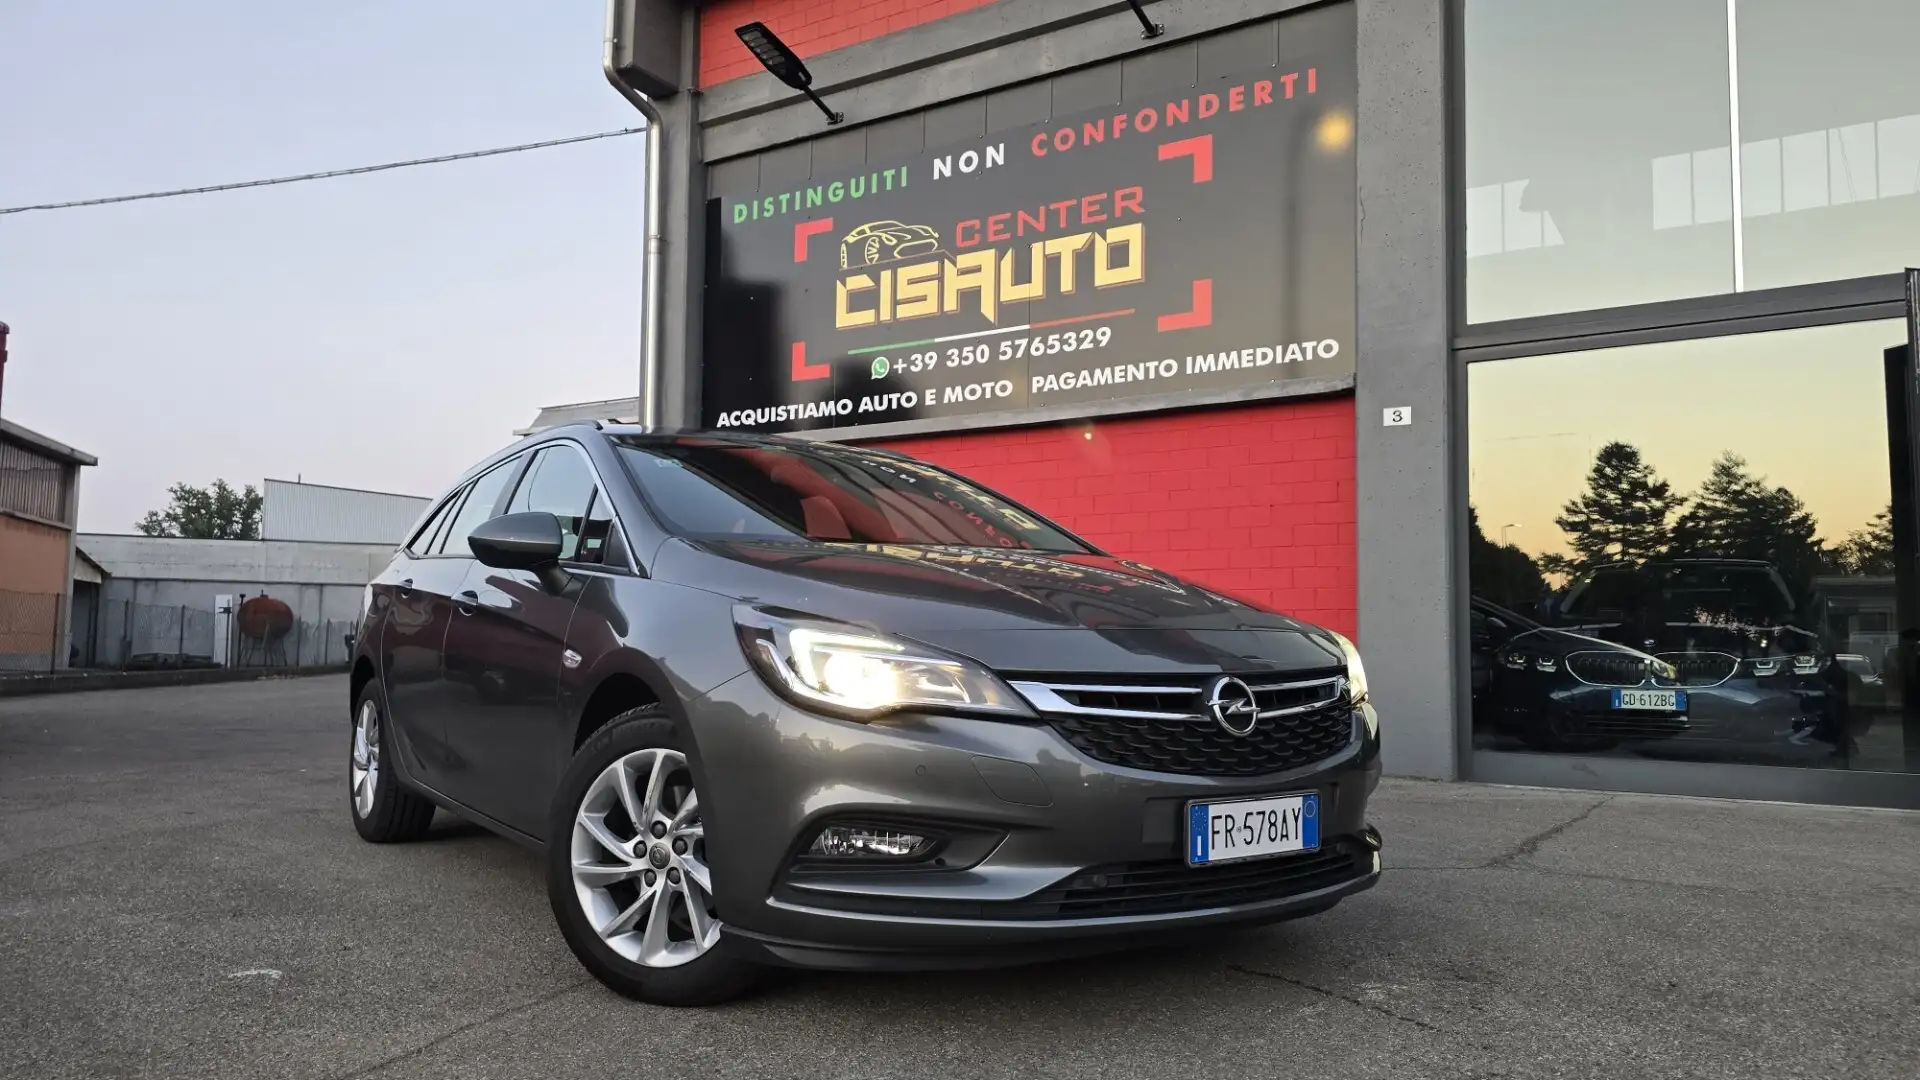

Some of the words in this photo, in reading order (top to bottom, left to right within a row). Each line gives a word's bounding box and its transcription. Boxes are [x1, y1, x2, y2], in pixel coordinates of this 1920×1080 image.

[733, 166, 908, 224] DISTINGUITI
[932, 143, 1005, 180] NON
[1031, 68, 1317, 156] CONFONDERTI
[955, 186, 1145, 247] CENTER
[835, 222, 1146, 330] CISAUTO
[716, 398, 853, 428] ACQUISTIAMO
[858, 390, 918, 412] AUTO
[924, 388, 937, 406] E
[943, 379, 1013, 403] MOTO
[1031, 359, 1178, 394] PAGAMENTO
[1186, 338, 1340, 375] IMMEDIATO
[892, 351, 938, 375] +39
[946, 344, 989, 367] 350
[998, 326, 1112, 360] 5765329
[1392, 409, 1403, 423] 3
